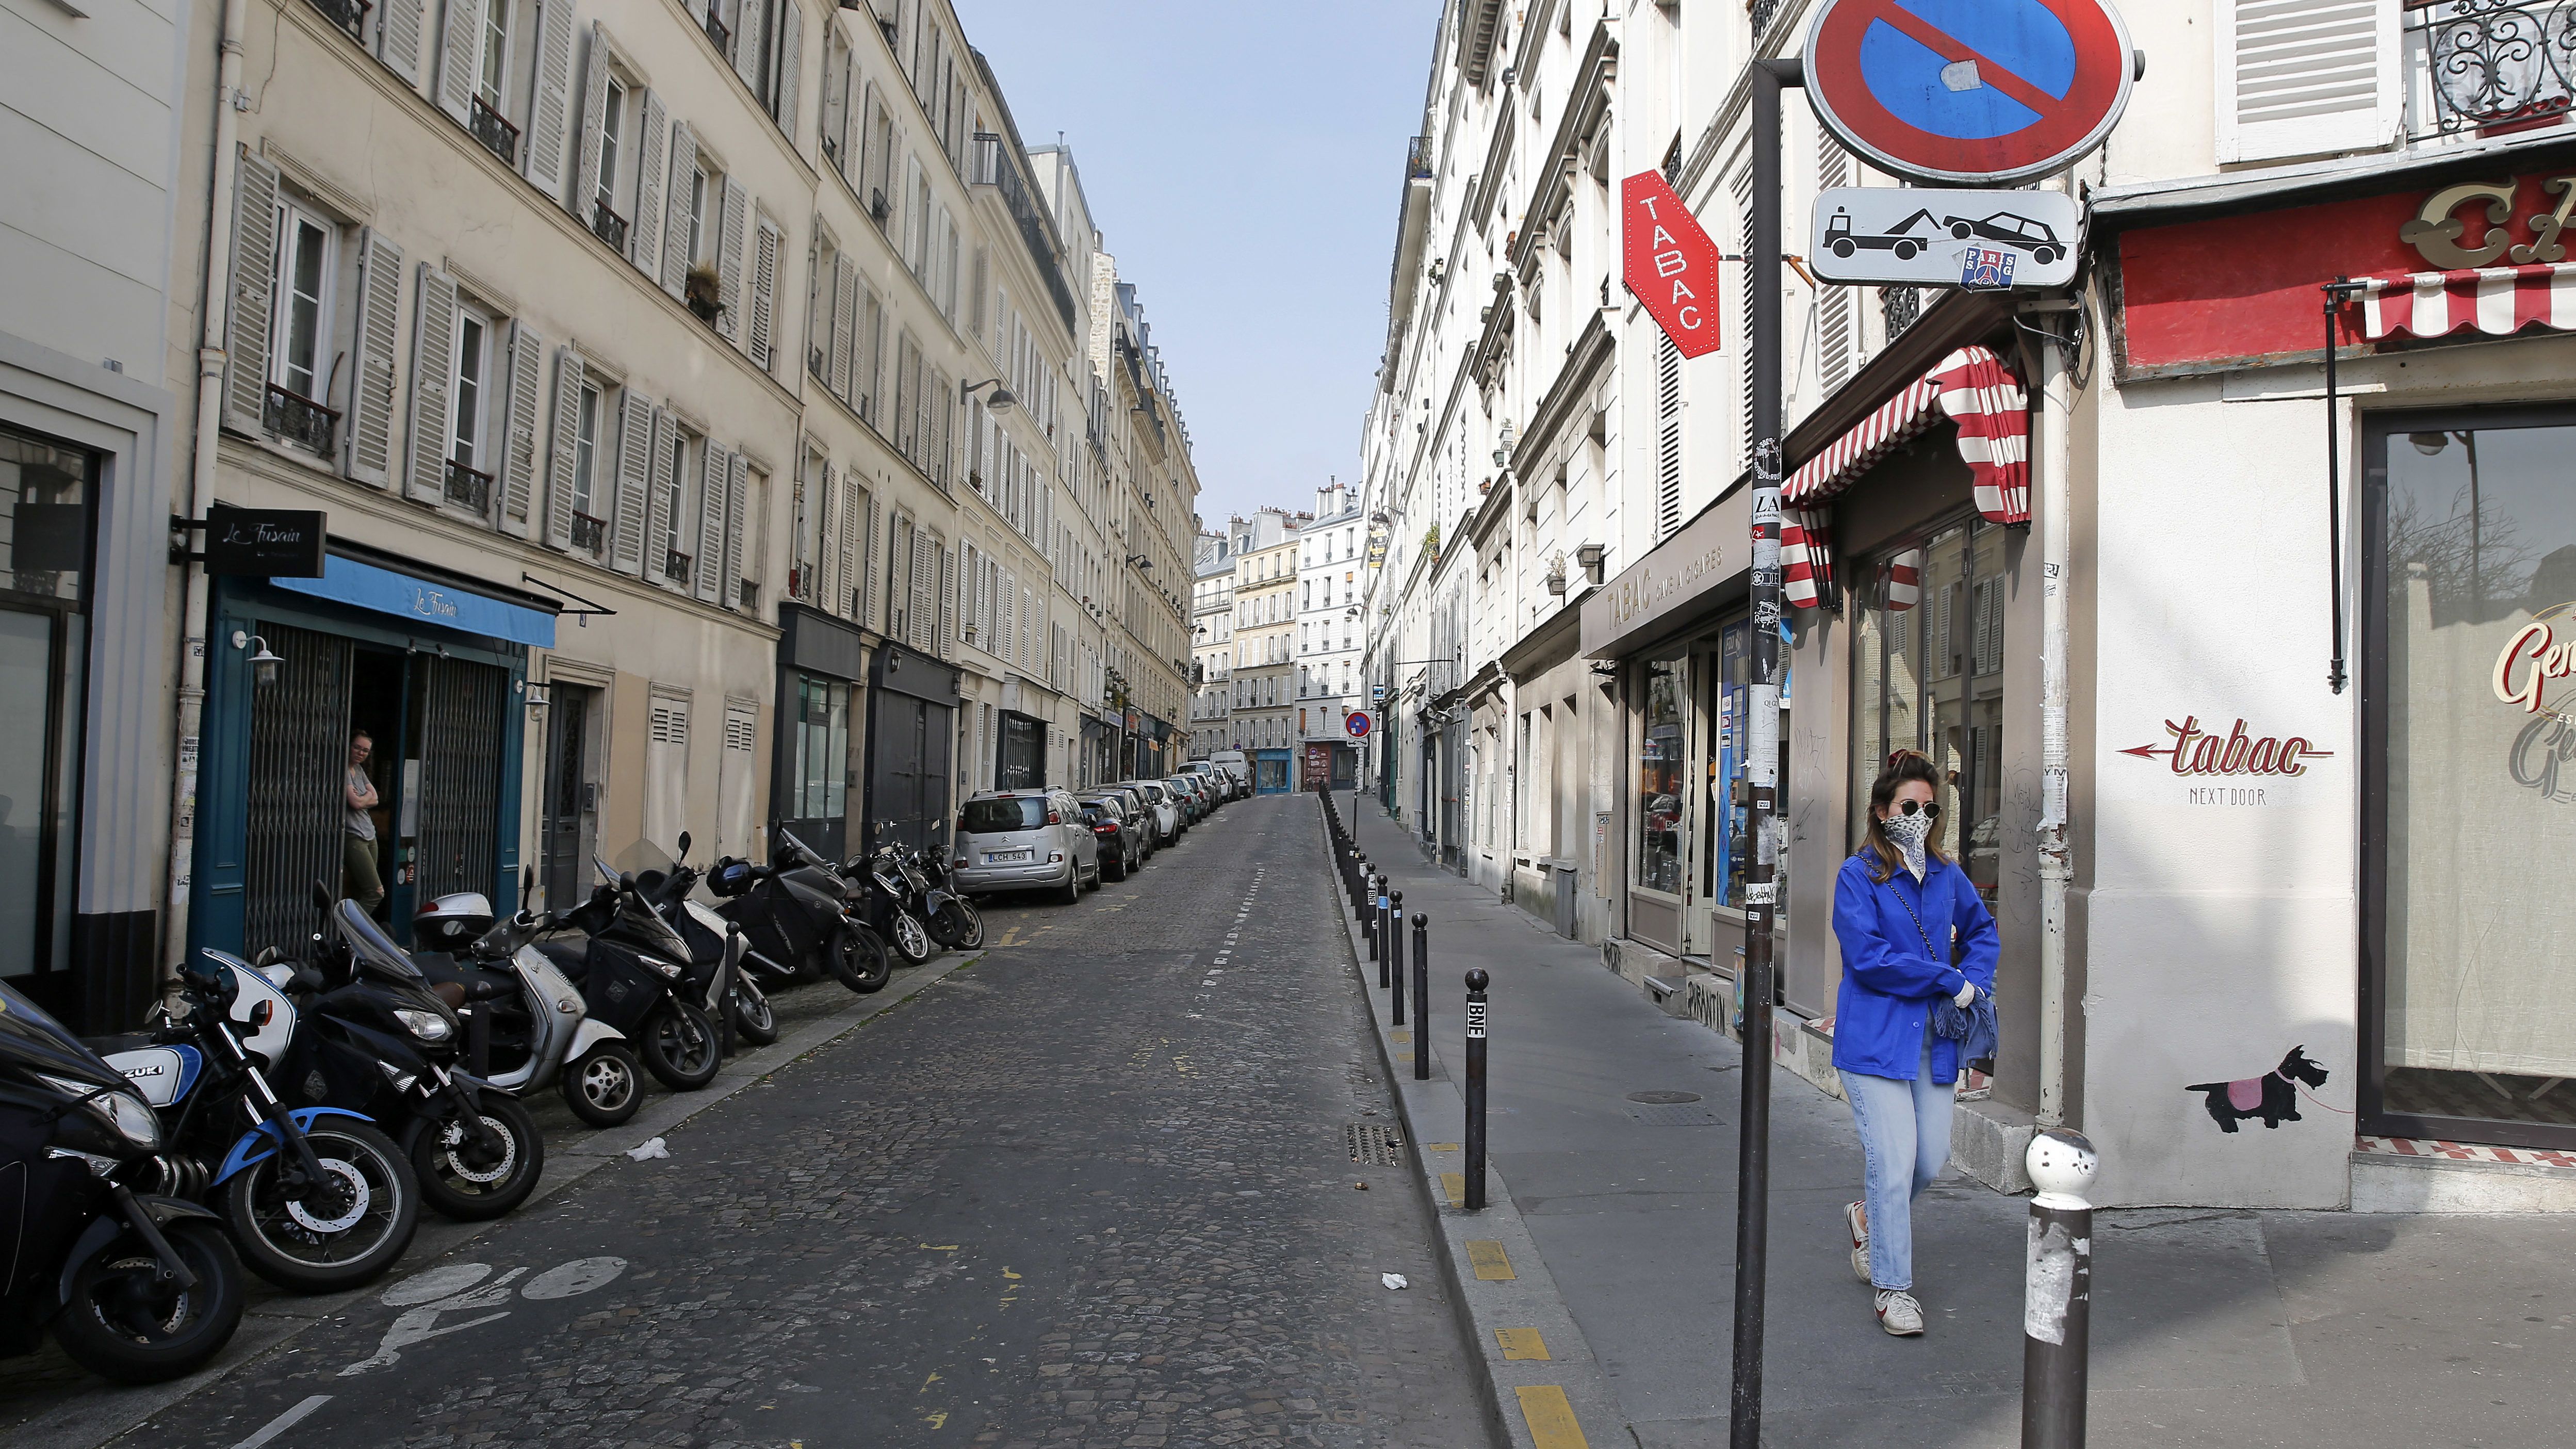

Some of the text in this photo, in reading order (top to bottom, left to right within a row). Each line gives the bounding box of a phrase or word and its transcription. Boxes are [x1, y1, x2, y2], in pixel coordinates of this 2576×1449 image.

[1640, 196, 1702, 331] TABAC
[1966, 250, 2014, 266] PARIS
[1755, 495, 1780, 513] LA
[222, 523, 300, 545] Le Fusain
[1608, 567, 1651, 630] TABAC
[1655, 575, 1673, 602] CAVE
[1676, 570, 1683, 590] A
[1686, 545, 1723, 584] CIGARES
[414, 588, 457, 618] Le Fusain
[1725, 634, 1735, 651] FDJ
[2164, 715, 2313, 778] tabac
[2190, 788, 2267, 806] NEXT DOOR
[1468, 1005, 1485, 1035] BNE
[121, 1065, 164, 1079] ZUKI
